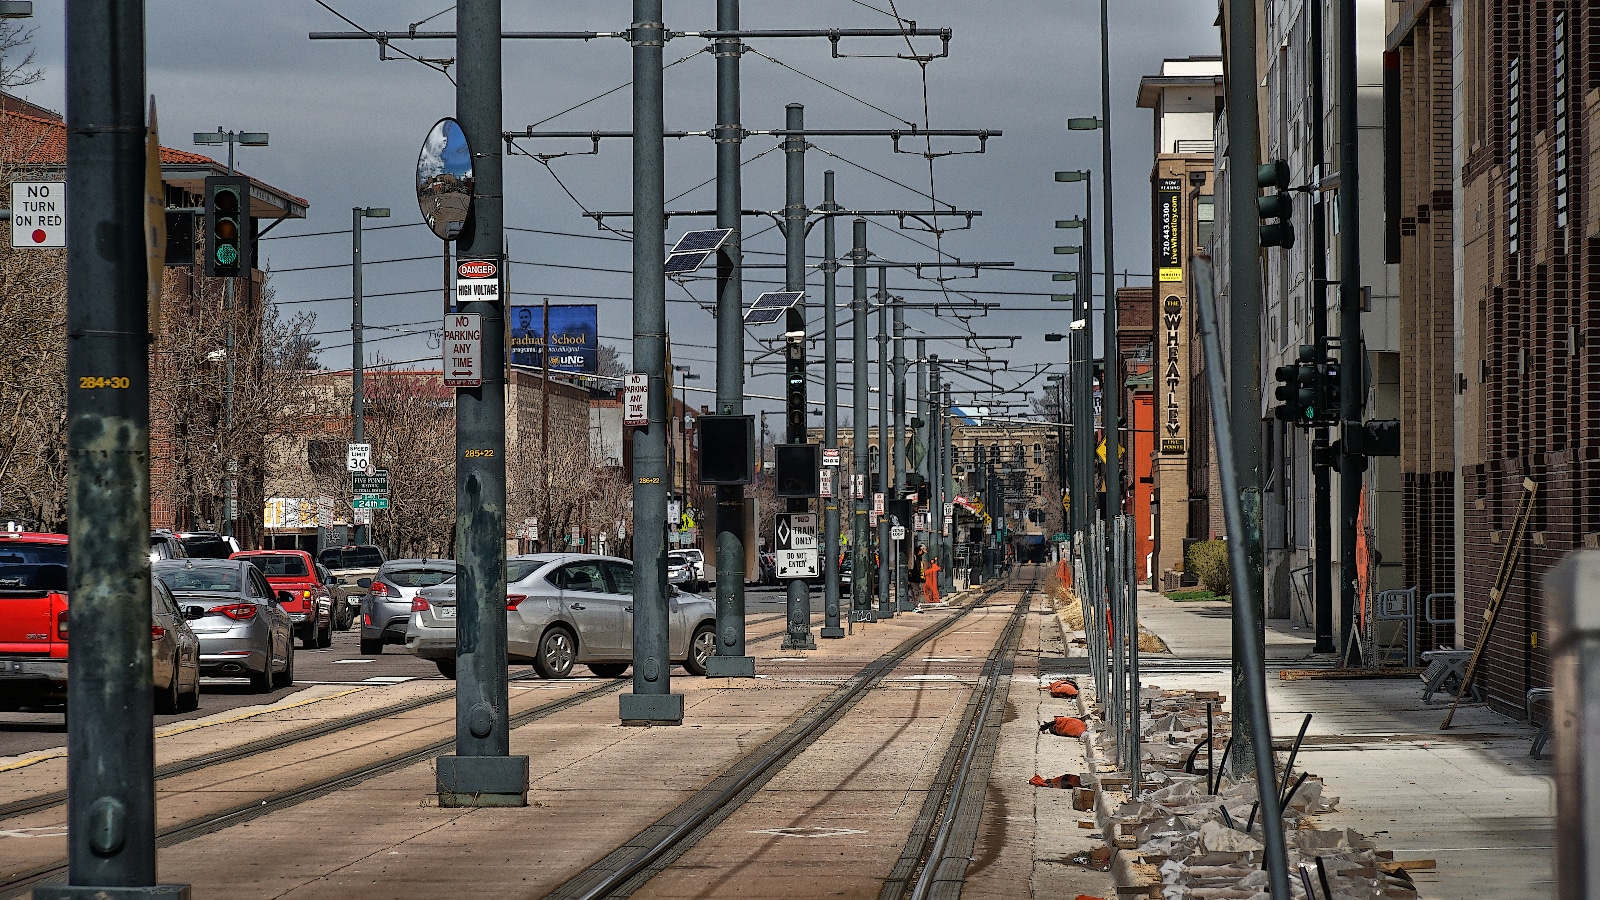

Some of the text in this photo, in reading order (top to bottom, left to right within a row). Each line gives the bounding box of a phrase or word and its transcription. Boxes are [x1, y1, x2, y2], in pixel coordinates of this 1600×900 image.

[28, 186, 49, 198] NO
[23, 202, 55, 212] TURN
[16, 216, 62, 226] ON RED
[1170, 196, 1178, 264] LiveWheatley.com
[461, 266, 493, 274] DANGER
[458, 284, 498, 296] HIGH VOLTAGE
[456, 317, 468, 327] NO
[445, 330, 480, 340] PARKING
[552, 332, 586, 344] School
[453, 344, 471, 354] ANY
[452, 358, 472, 368] TIME
[560, 356, 584, 365] UNC
[632, 376, 640, 384] NO
[1164, 314, 1182, 437] WHEATLEY
[80, 376, 130, 388] 284+30
[465, 450, 494, 458] 285+22
[350, 458, 368, 469] 30
[793, 526, 814, 535] TRAIN
